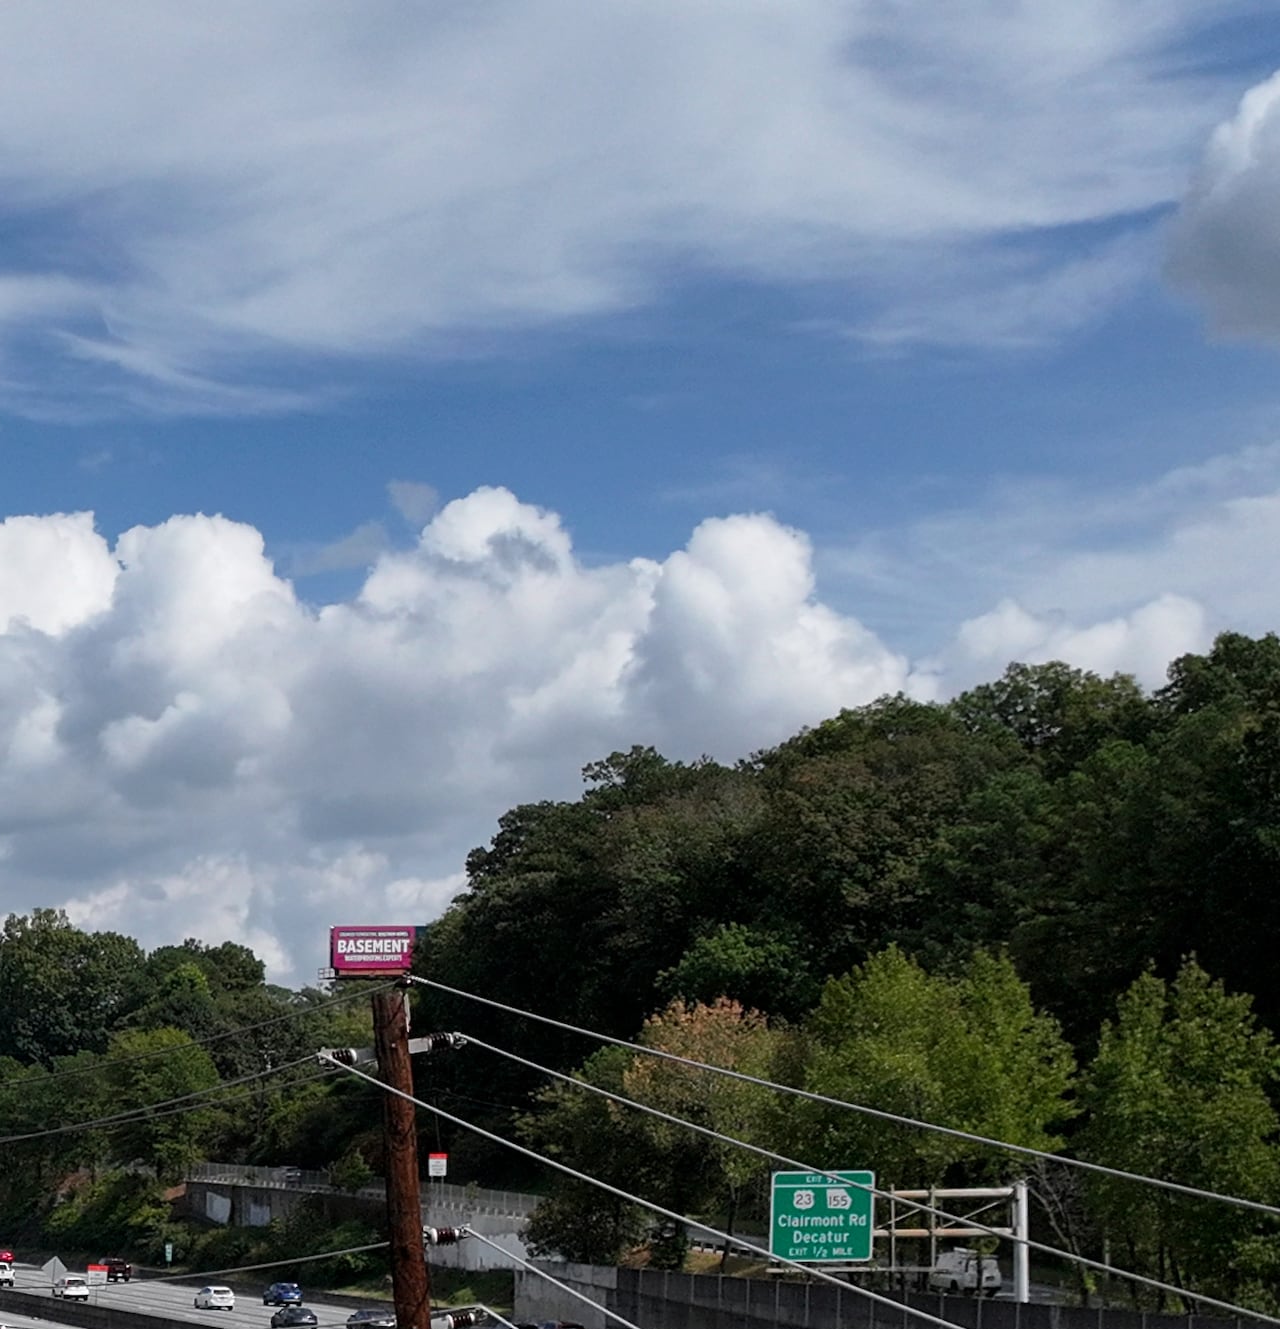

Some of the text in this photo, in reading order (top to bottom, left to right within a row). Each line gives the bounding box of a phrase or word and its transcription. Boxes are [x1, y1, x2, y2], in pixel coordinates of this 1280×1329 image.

[337, 939, 410, 953] BASEMENT
[795, 1193, 848, 1207] 23 155
[778, 1213, 867, 1227] Clairmont Rd
[793, 1231, 850, 1244] Decatur
[788, 1248, 808, 1256] EXIT
[832, 1247, 854, 1256] MILE
